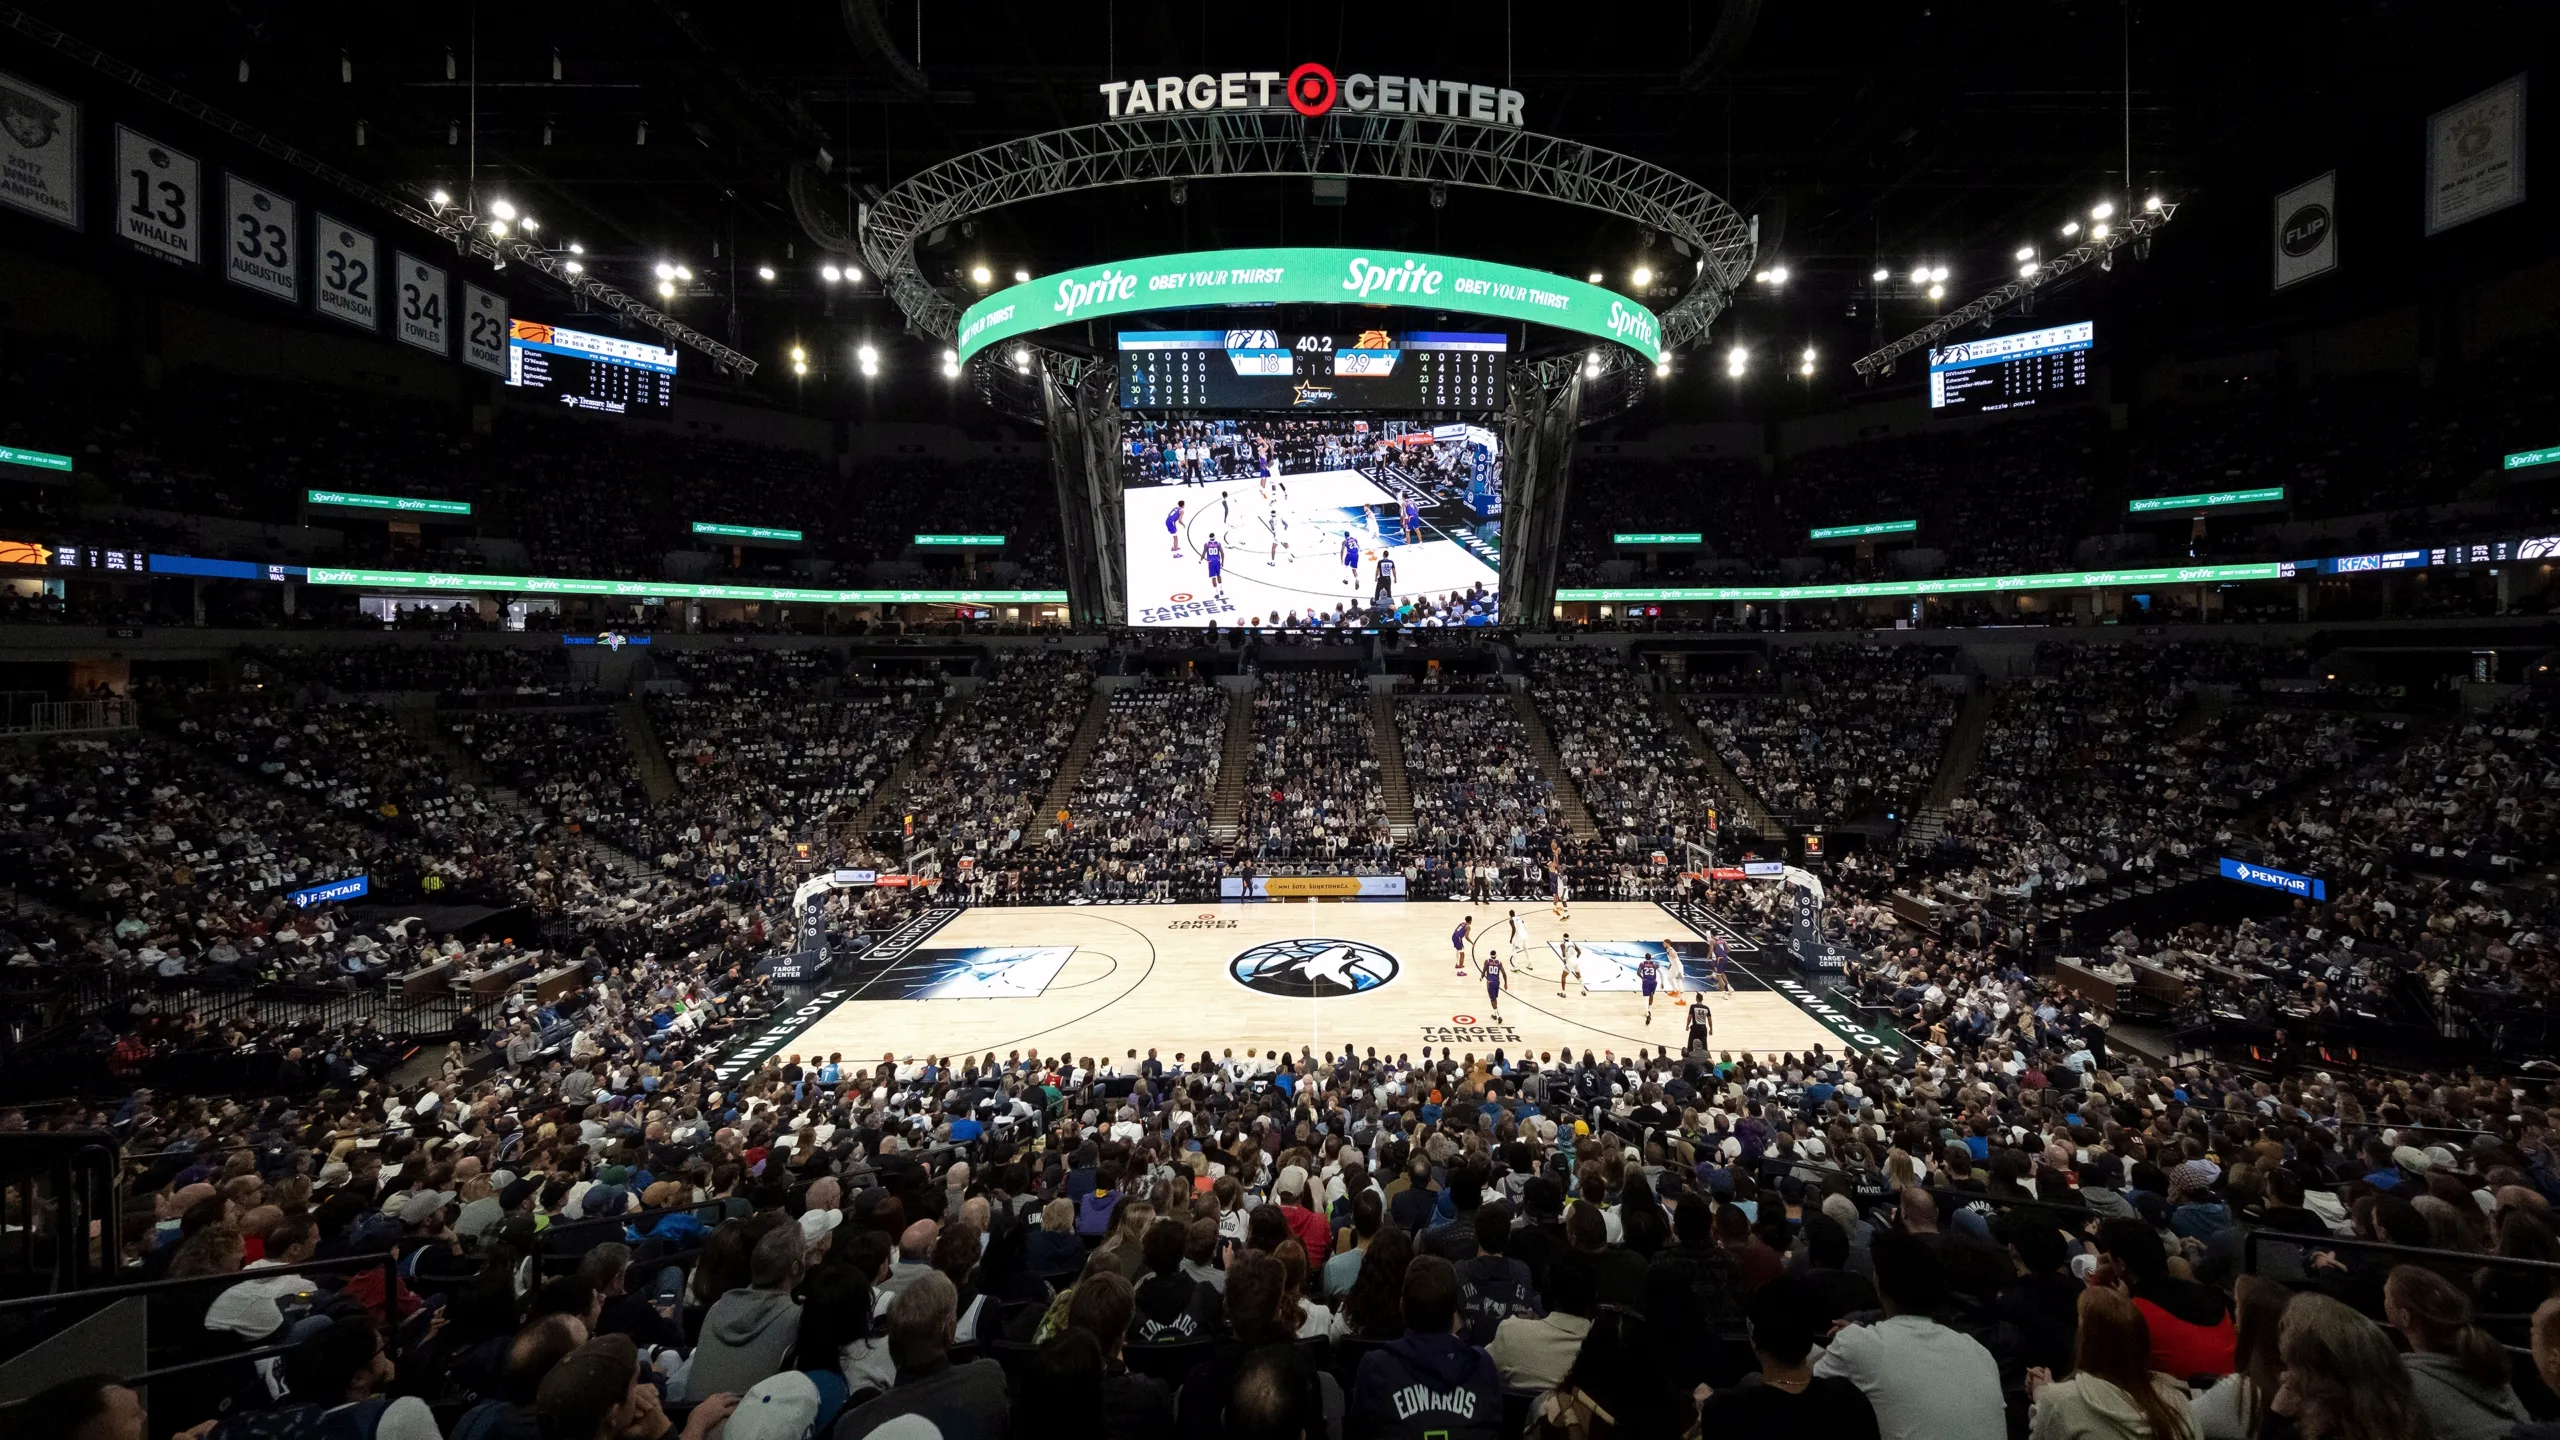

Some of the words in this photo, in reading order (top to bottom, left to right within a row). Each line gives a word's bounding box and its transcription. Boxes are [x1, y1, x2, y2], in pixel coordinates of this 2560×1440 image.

[1100, 71, 1280, 117] TARGET
[1344, 73, 1525, 126] CENTER
[8, 154, 42, 173] 2017
[2, 165, 47, 192] WNBA
[131, 169, 186, 229] 13
[130, 218, 188, 252] WHALEN
[2286, 218, 2324, 244] FLIP
[237, 213, 288, 268] 33
[232, 256, 293, 289] AUGUSTUS
[325, 250, 367, 300] 32
[1342, 258, 1443, 298] Sprite
[1455, 278, 1492, 295] OBEY
[1492, 283, 1528, 300] YOUR
[1528, 290, 1570, 310] THIRST
[1054, 270, 1138, 316] Sprite
[1149, 274, 1188, 291] OBEY
[1188, 271, 1229, 288] YOUR
[1231, 268, 1284, 284] THIRST
[322, 290, 371, 318] BRUNSON
[403, 284, 442, 328] 34
[1606, 300, 1653, 346] Sprite
[406, 322, 440, 344] FOWLES
[470, 312, 502, 351] 23
[1296, 336, 1332, 352] 40.2
[472, 346, 500, 365] MOORE
[1148, 352, 1154, 361] 0
[1165, 352, 1171, 361] 0
[1182, 352, 1188, 361] 0
[1420, 353, 1430, 361] 00
[1438, 353, 1445, 362] 0
[1456, 353, 1461, 362] 2
[1472, 353, 1478, 363] 0
[524, 365, 547, 373] Booker
[1148, 363, 1155, 372] 4
[1182, 363, 1188, 372] 0
[1260, 354, 1280, 373] 18
[1296, 366, 1302, 374] 6
[1312, 364, 1315, 375] 1
[1325, 366, 1331, 374] 6
[1346, 354, 1370, 374] 29
[1438, 364, 1444, 373] 4
[1132, 374, 1138, 383] 11
[1149, 374, 1155, 383] 0
[1166, 374, 1172, 383] 0
[1182, 374, 1189, 383] 0
[1438, 374, 1444, 383] 5
[1455, 375, 1461, 384] 0
[1471, 375, 1478, 384] 0
[1131, 386, 1141, 394] 30
[1149, 385, 1156, 394] 7
[1166, 385, 1172, 394] 0
[1182, 385, 1188, 394] 2
[1302, 388, 1332, 400] Starkey
[1438, 385, 1444, 394] 2
[1455, 386, 1460, 394] 0
[1471, 386, 1477, 395] 0
[606, 400, 626, 410] Island
[1134, 396, 1139, 405] 5
[1149, 395, 1156, 405] 2
[1166, 396, 1172, 405] 2
[1183, 395, 1189, 405] 3
[1436, 396, 1446, 405] 15
[1454, 397, 1460, 405] 2
[1471, 397, 1476, 405] 3
[2509, 453, 2543, 466] Sprite
[313, 493, 345, 502] Sprite
[2208, 494, 2236, 504] Sprite
[396, 500, 426, 509] Sprite
[2134, 500, 2160, 510] Sprite
[2338, 555, 2380, 572] KFAN
[316, 571, 357, 582] Sprite
[426, 575, 464, 586] Sprite
[2082, 573, 2116, 585] Sprite
[2177, 569, 2214, 581] Sprite
[525, 580, 560, 590] Sprite
[1995, 577, 2026, 589] Sprite
[1140, 597, 1229, 616] TARGET
[1142, 605, 1236, 624] CENTER
[563, 635, 594, 645] Treasure
[630, 635, 651, 644] Island
[2252, 870, 2305, 890] PENTAIR
[888, 909, 952, 948] CHIPOTLE
[1488, 965, 1499, 975] 00
[1644, 967, 1654, 976] 23
[714, 989, 846, 1080] MINNESOTA
[1586, 1078, 1592, 1087] 5
[1393, 1384, 1476, 1420] EDWARDS
